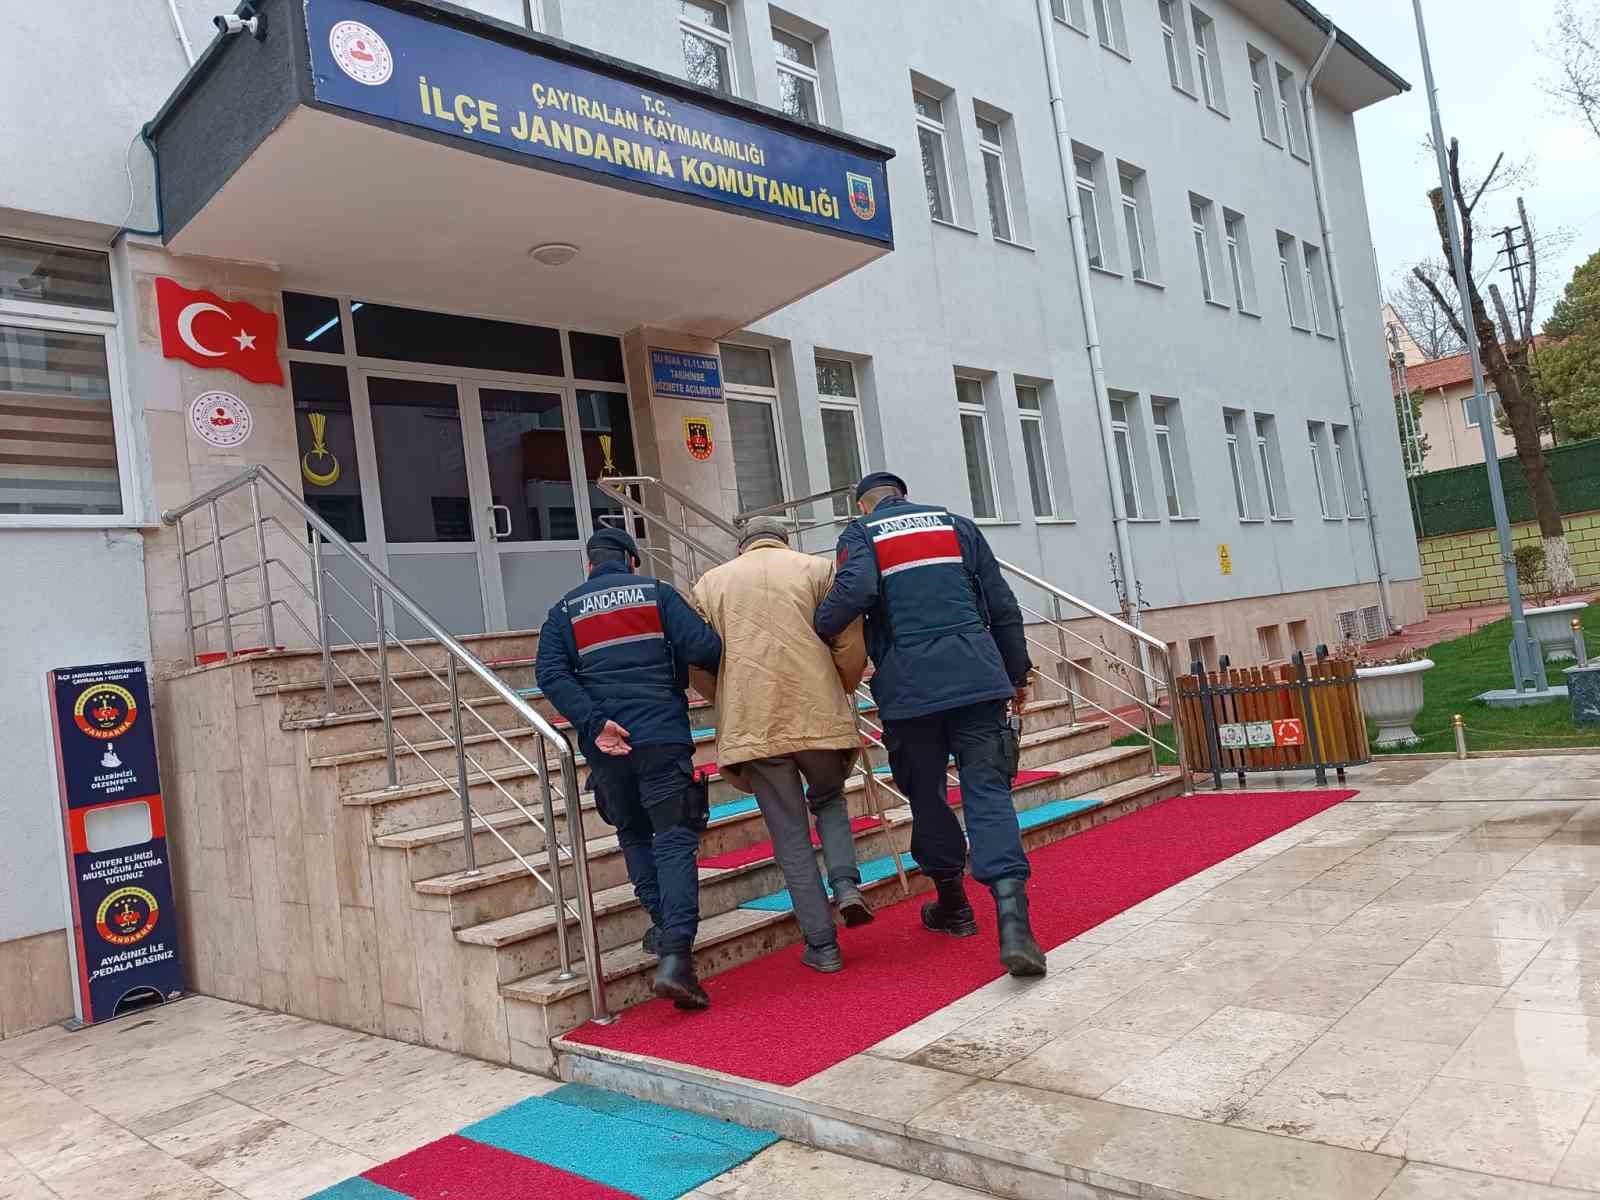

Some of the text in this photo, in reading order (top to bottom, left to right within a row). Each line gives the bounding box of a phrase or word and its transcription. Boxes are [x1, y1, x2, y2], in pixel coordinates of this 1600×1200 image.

[641, 95, 671, 117] T.C.
[532, 82, 765, 166] ÇAYIRALAN KAYMAKAMLIĞI
[419, 76, 840, 220] İLÇE JANDARMA KOMUTANLIĞI
[878, 515, 944, 535] JANDARMA
[580, 588, 645, 613] JANDARMA
[82, 858, 163, 881] MUSLUĞUN ALTINA
[90, 850, 153, 870] LÜTFEN ELİNİZİ
[105, 871, 144, 885] TUTUNUZ
[93, 950, 174, 978] PEDALA BASINIZ
[101, 943, 164, 966] AYAĞINIZ İLE
